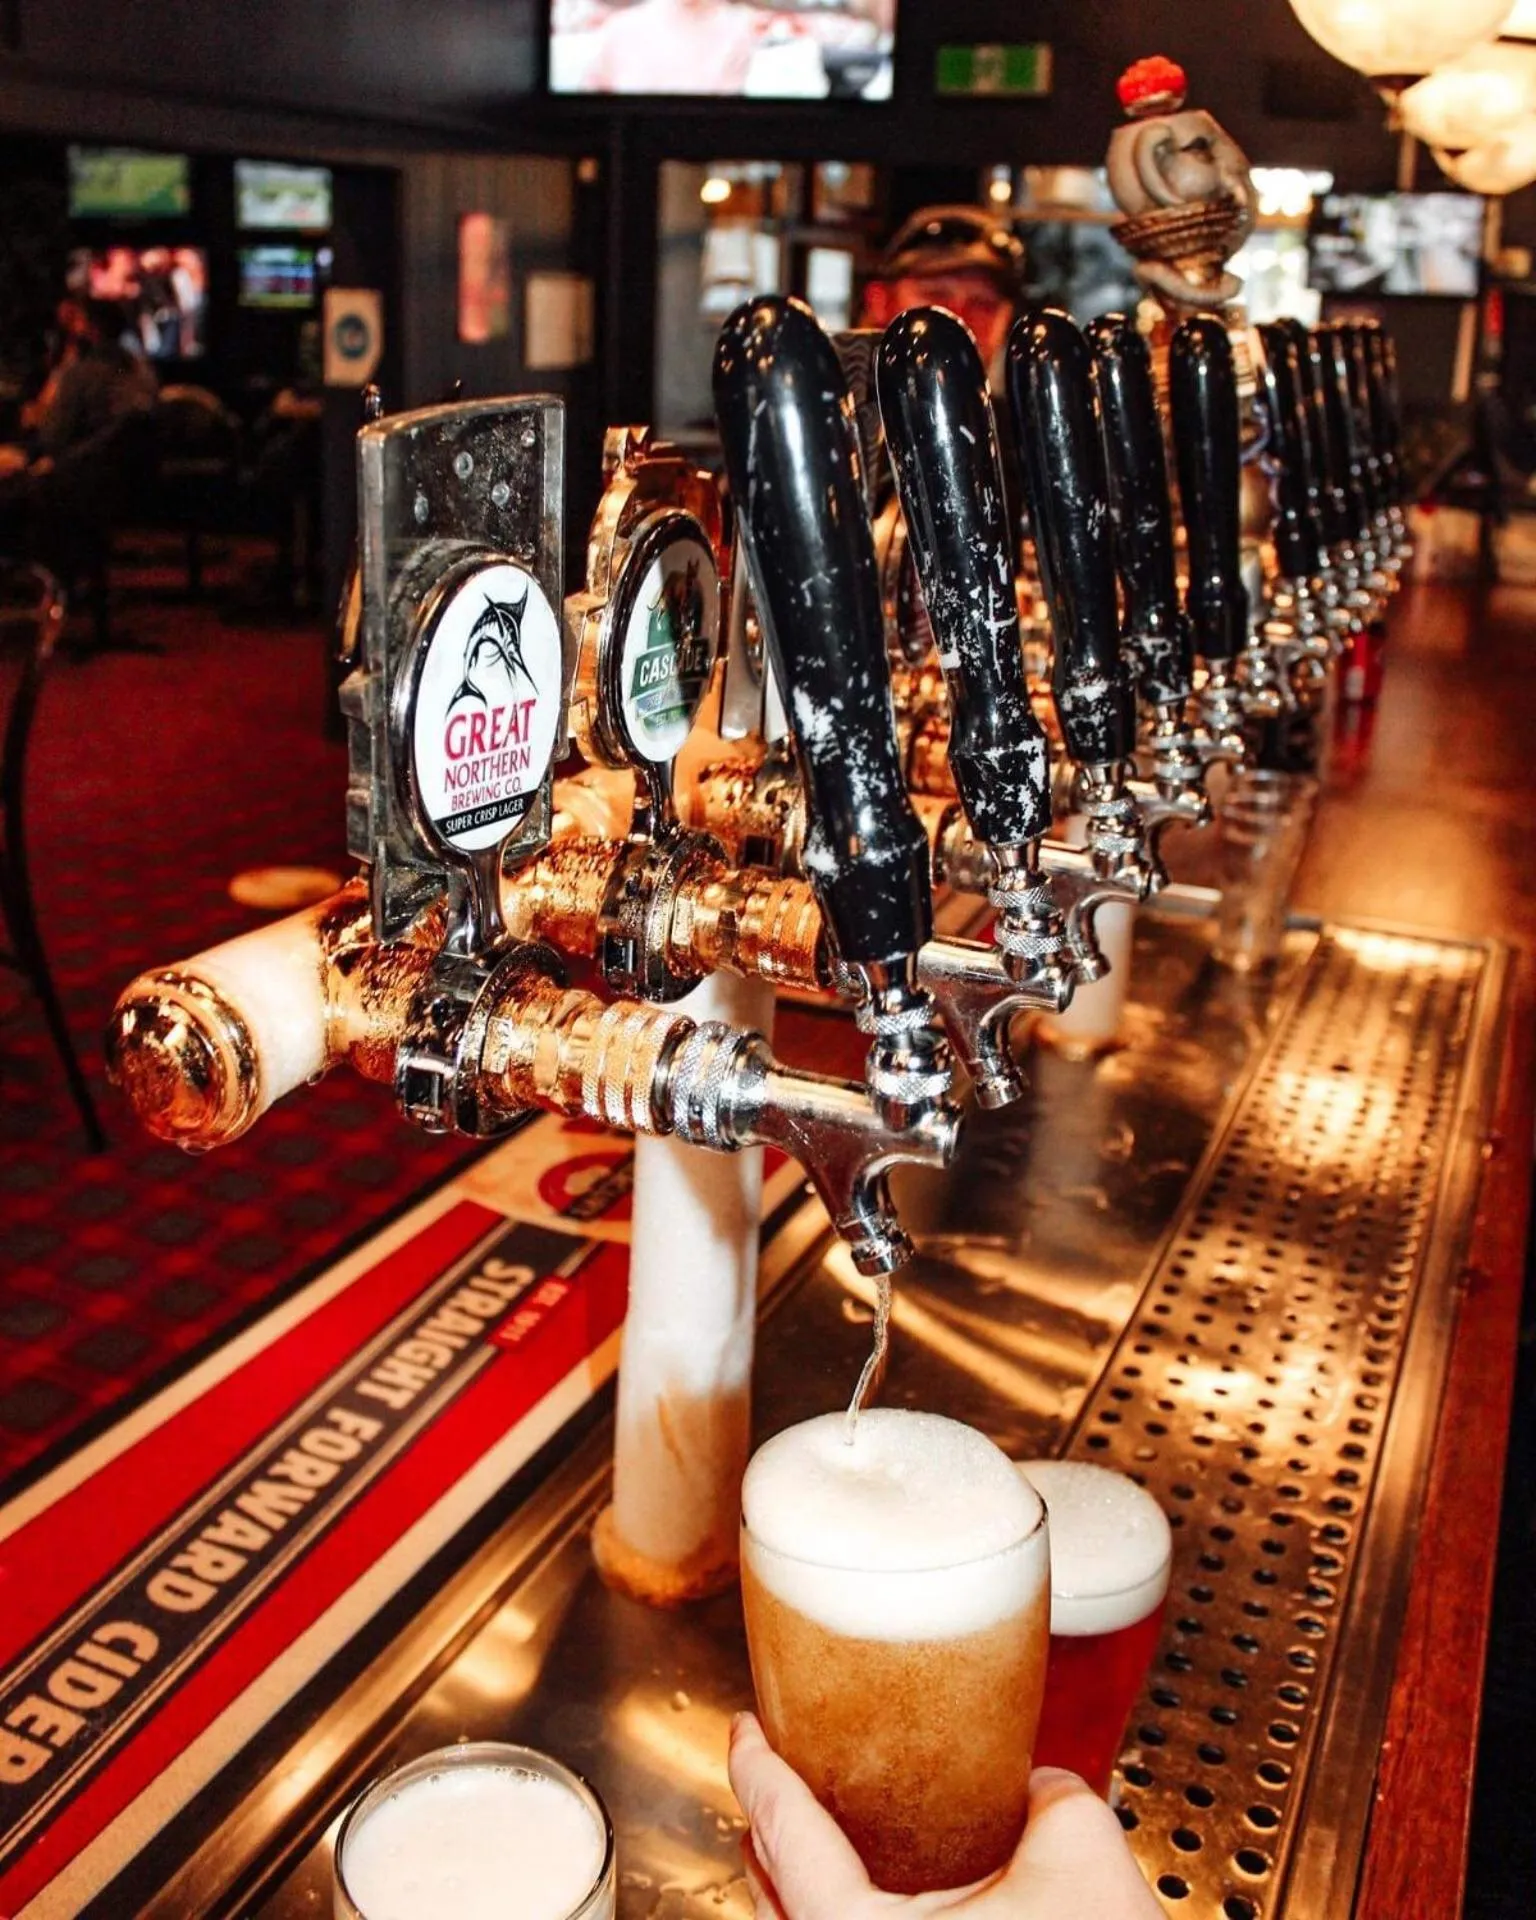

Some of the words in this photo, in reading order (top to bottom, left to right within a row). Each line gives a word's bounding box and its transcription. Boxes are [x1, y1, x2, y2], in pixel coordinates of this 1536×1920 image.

[444, 698, 537, 761] GREAT
[444, 746, 531, 793] NORTHERN
[451, 782, 501, 811] BREWING
[504, 776, 522, 796] CO.
[445, 814, 473, 834] SUPER
[474, 806, 498, 825] CRISP
[500, 798, 525, 816] LAGER
[355, 1258, 536, 1410] STRAIGHT
[145, 1407, 384, 1613] FORWARD
[0, 1620, 160, 1785] CIDER
